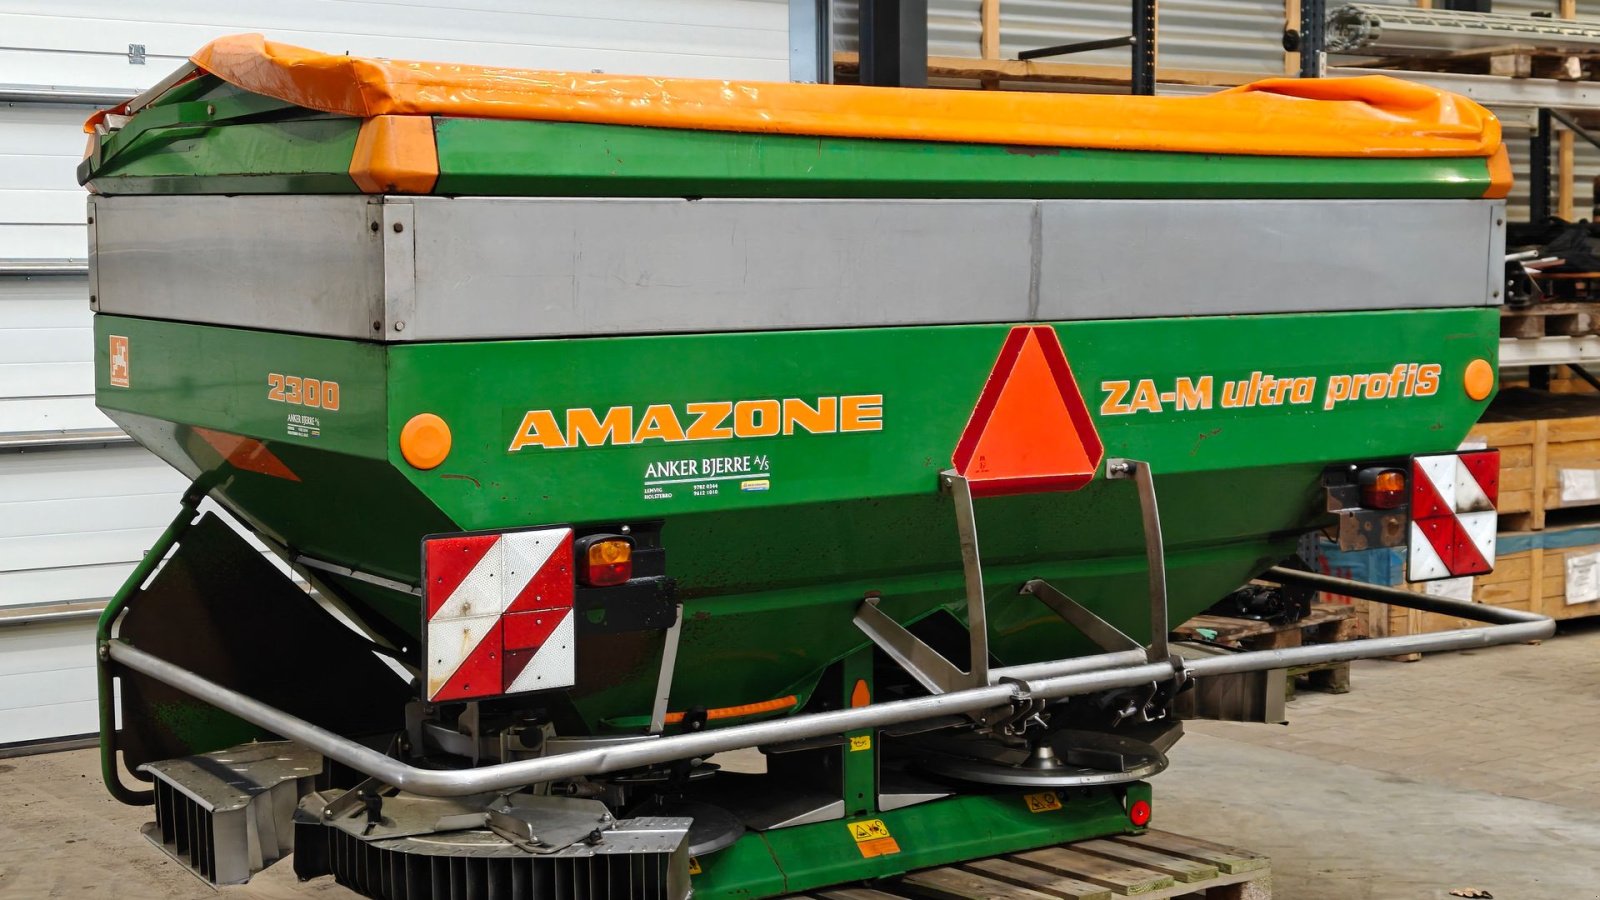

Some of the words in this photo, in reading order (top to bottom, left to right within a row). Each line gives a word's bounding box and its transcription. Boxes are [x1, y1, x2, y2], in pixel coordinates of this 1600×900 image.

[267, 372, 340, 412] 2300
[1100, 375, 1213, 416] ZA-M
[1221, 371, 1317, 408] ultra
[508, 394, 884, 452] AMAZONE
[644, 459, 698, 478] ANKER
[702, 456, 751, 477] BJERRE
[754, 455, 770, 471] A/S
